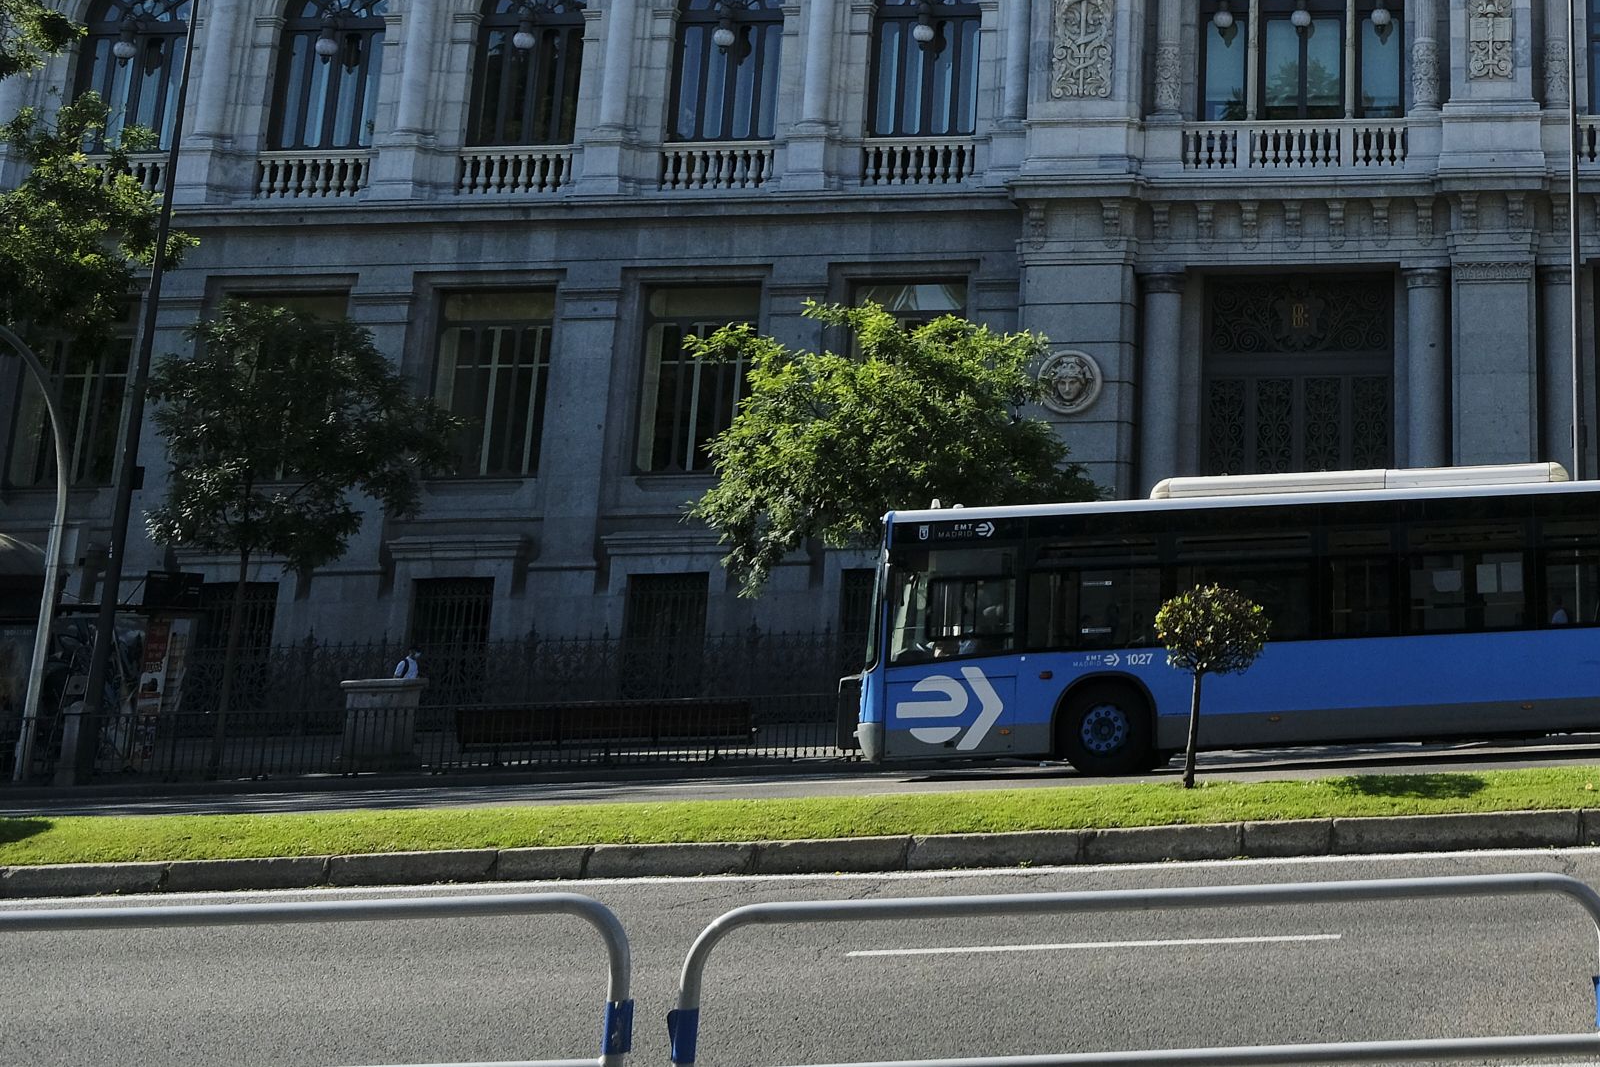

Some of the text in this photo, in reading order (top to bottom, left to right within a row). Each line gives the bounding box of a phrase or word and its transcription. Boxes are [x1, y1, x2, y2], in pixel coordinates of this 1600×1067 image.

[954, 523, 973, 531] EMT
[938, 530, 973, 538] MADRID
[1125, 653, 1153, 666] 1027
